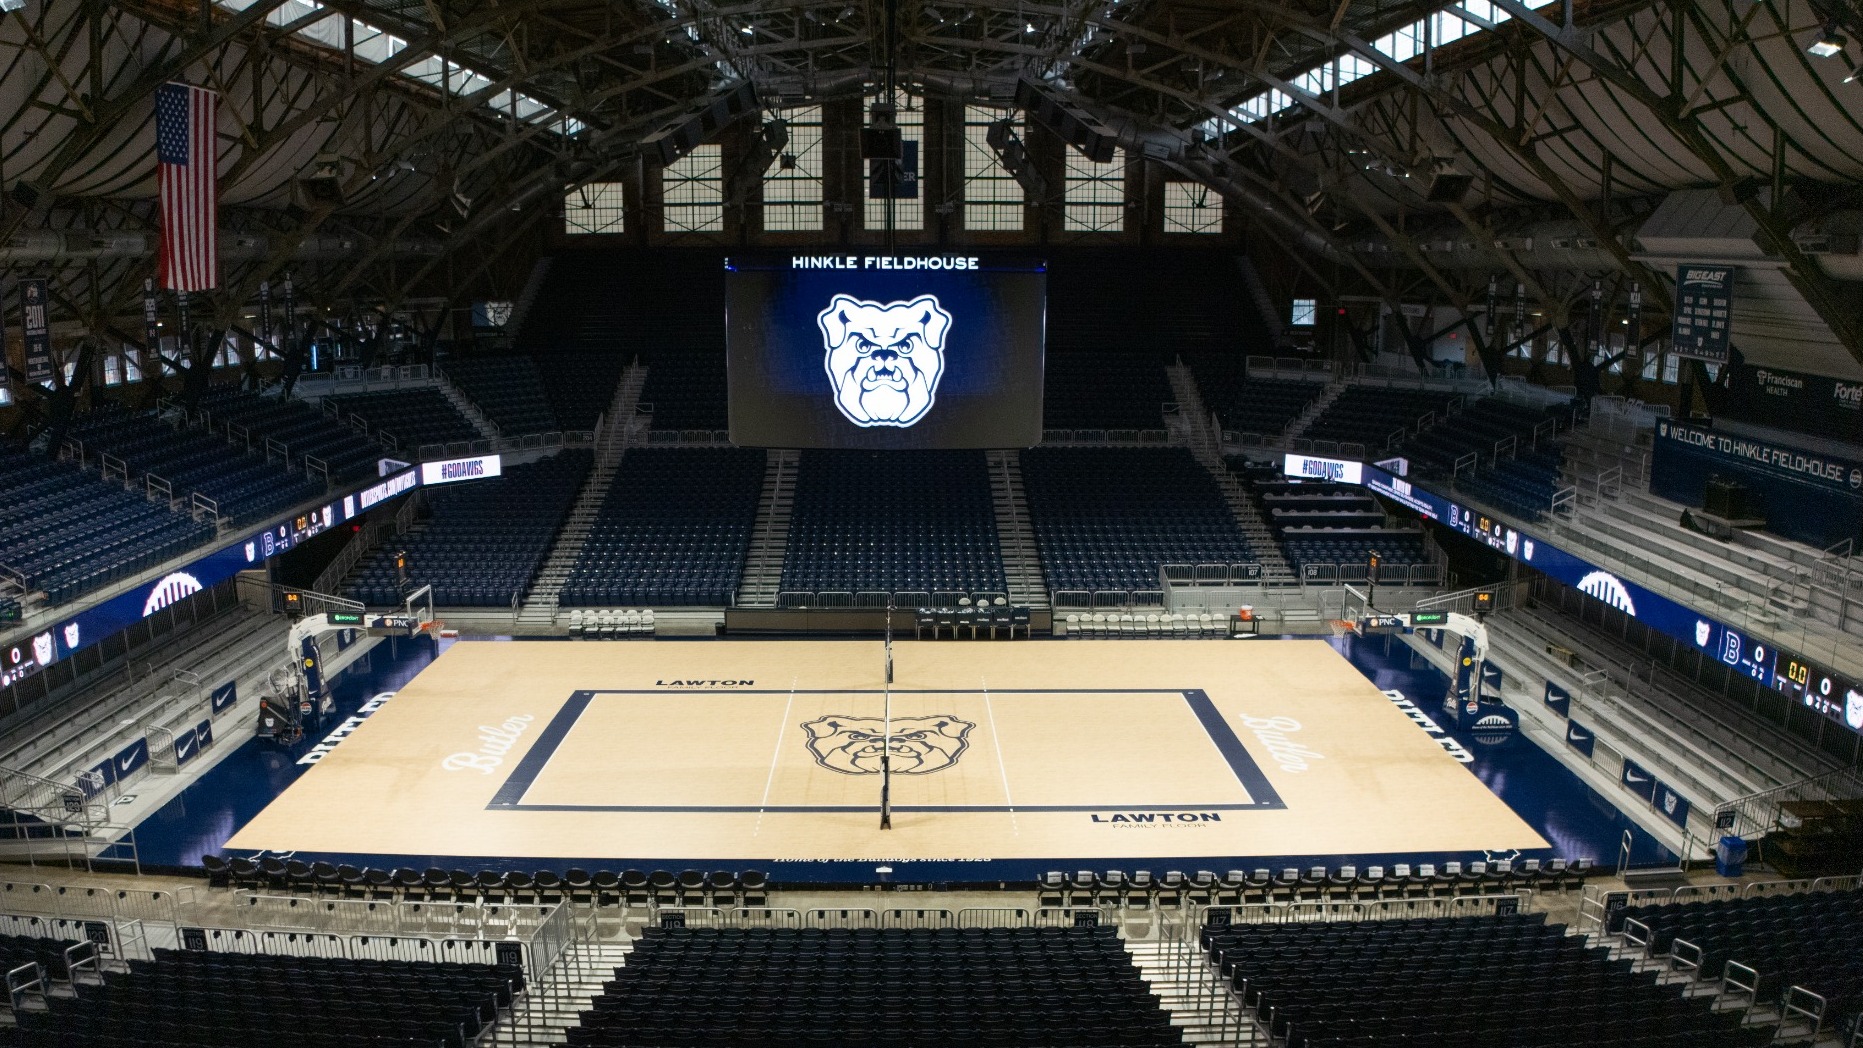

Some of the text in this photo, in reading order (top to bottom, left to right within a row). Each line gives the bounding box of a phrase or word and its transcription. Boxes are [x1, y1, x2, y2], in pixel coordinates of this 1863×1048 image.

[792, 256, 979, 270] HINKLE FIELDHOUSE
[25, 304, 45, 330] 2011
[1767, 372, 1803, 389] Franciscan
[1670, 426, 1715, 450] WELCOME
[1718, 437, 1732, 453] TO
[1732, 441, 1770, 464] HINKLE
[1771, 450, 1845, 482] FIELDHOUSE
[1302, 458, 1344, 479] #GODAWGS
[311, 512, 317, 523] 0
[1464, 510, 1470, 522] 0
[280, 525, 286, 538] 0
[1494, 524, 1501, 537] 0
[1378, 617, 1396, 626] PNC
[11, 647, 21, 664] 0
[1723, 630, 1740, 665] B
[1754, 646, 1764, 663] 0
[1788, 661, 1807, 685] 0.0
[1820, 677, 1831, 696] 0
[441, 713, 535, 775] Butler
[1239, 712, 1326, 774] Butler
[1091, 813, 1222, 823] LAWTON
[187, 936, 204, 950] 119
[501, 951, 518, 963] 119
